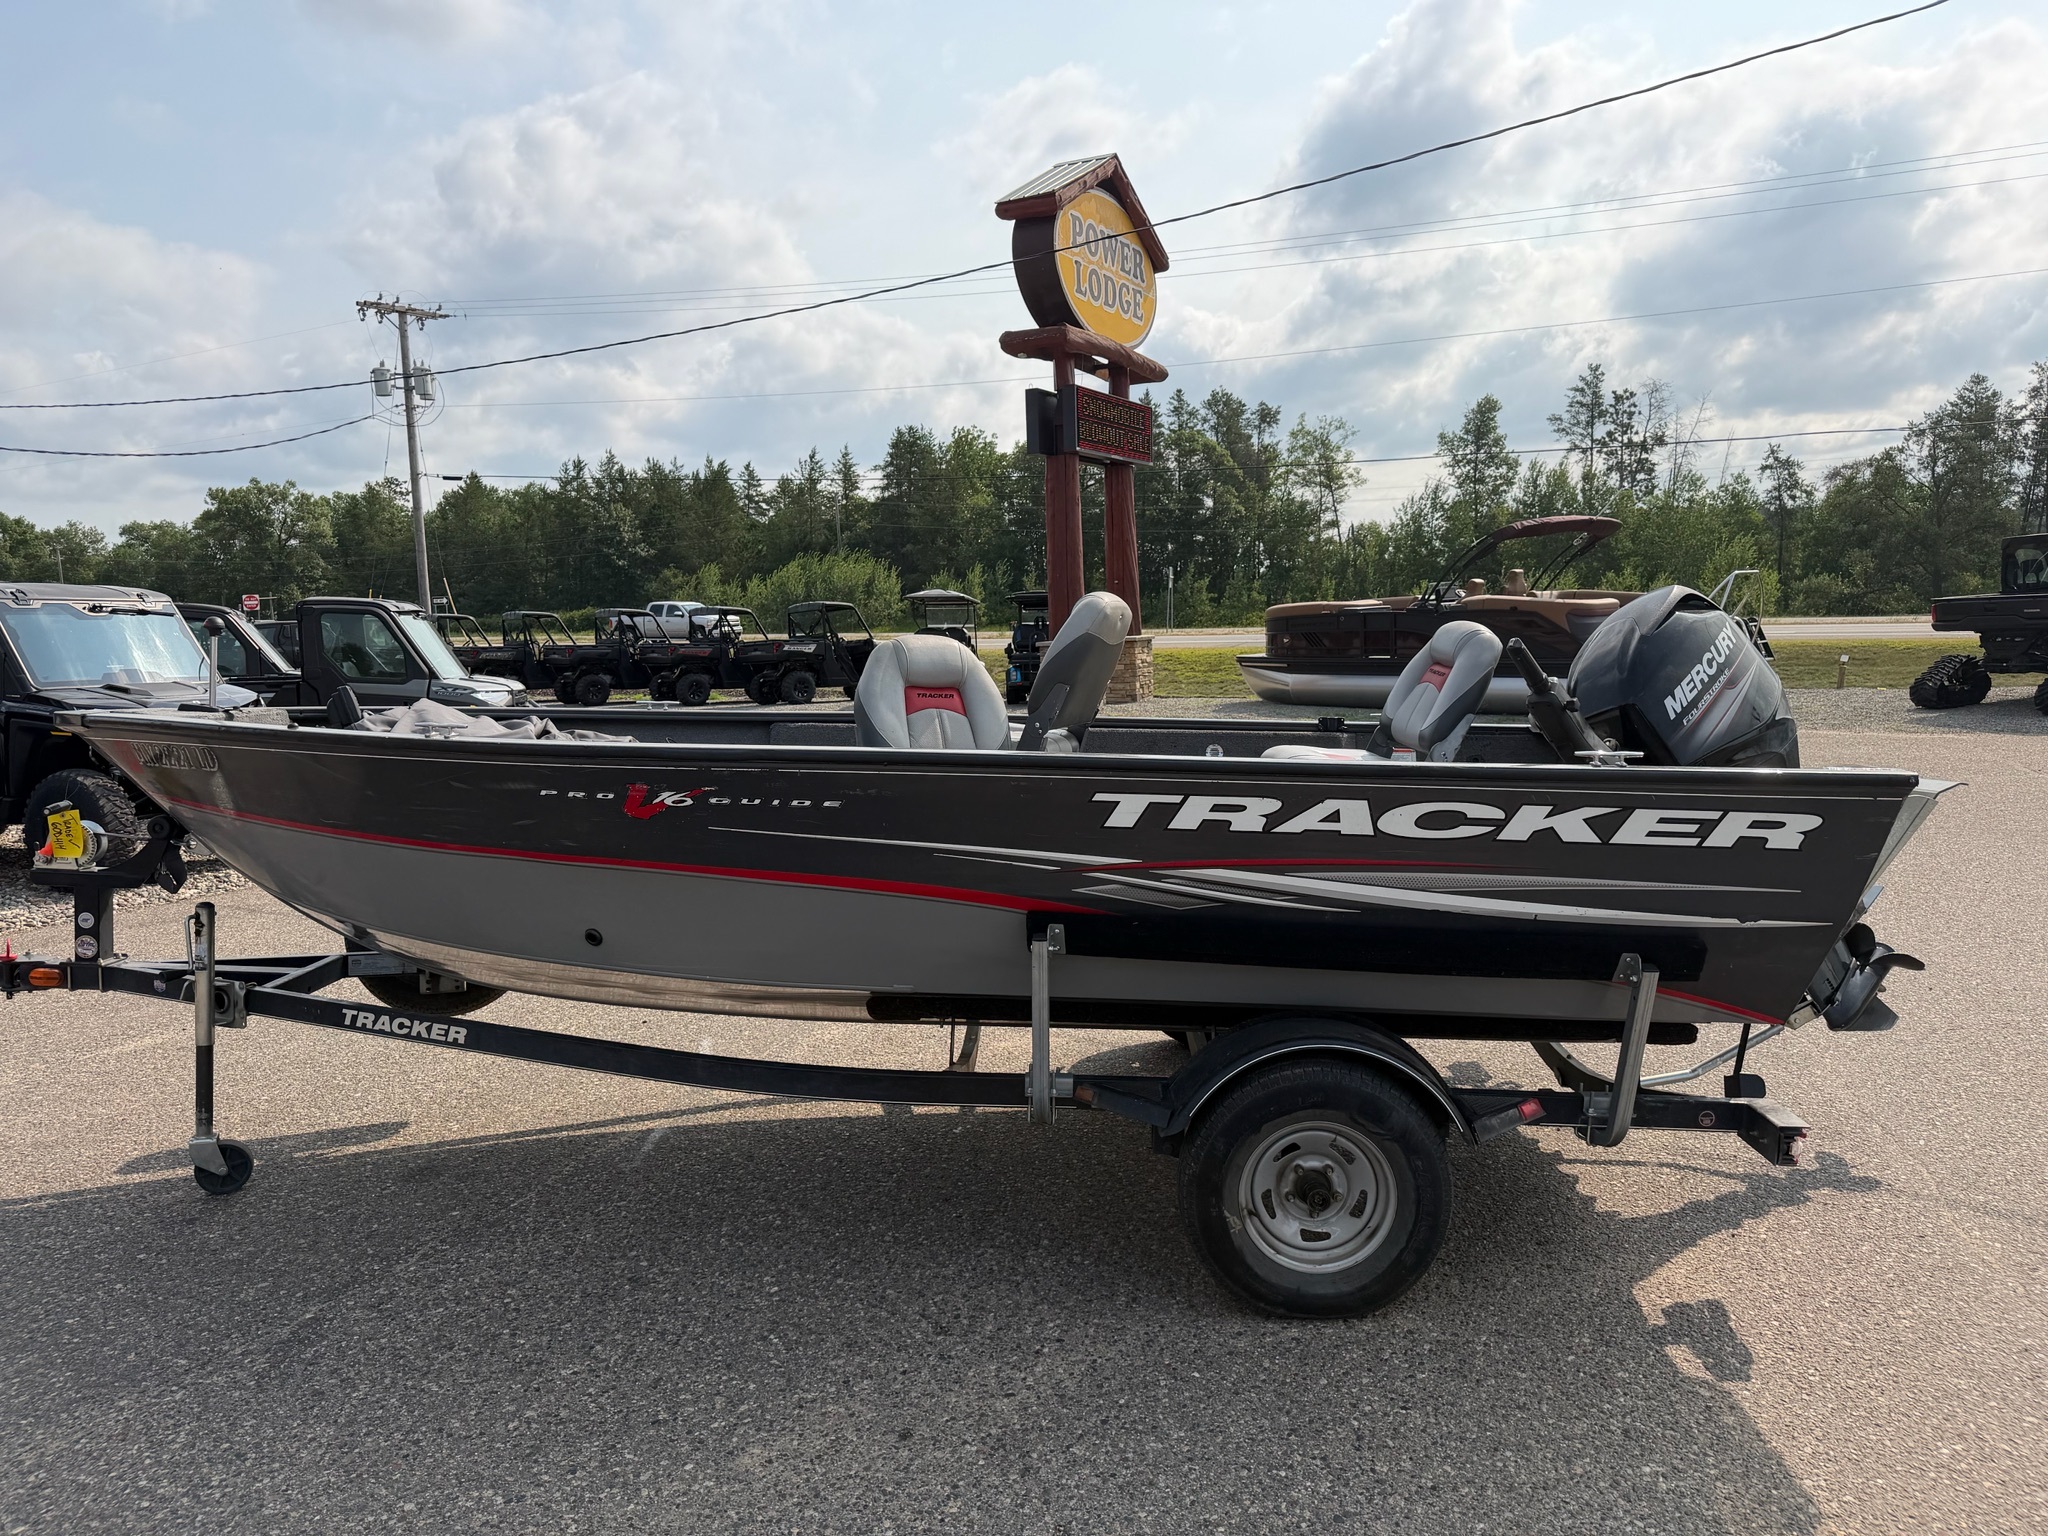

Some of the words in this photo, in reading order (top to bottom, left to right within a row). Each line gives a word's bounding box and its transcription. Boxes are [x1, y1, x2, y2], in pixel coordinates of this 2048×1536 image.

[1069, 211, 1146, 285] POWER
[1073, 258, 1145, 323] LODGE
[1082, 396, 1145, 429] SNOWMOBILE
[1079, 420, 1125, 447] BLOWOUT
[1128, 432, 1150, 453] SALE
[1663, 621, 1738, 721] MERCURY
[916, 692, 955, 700] TRACKER
[1682, 667, 1731, 726] FOURSTROKE
[539, 789, 615, 800] PRO
[708, 796, 846, 809] GUIDE
[1089, 793, 1825, 851] TRACKER
[341, 1008, 468, 1045] TRACKER
